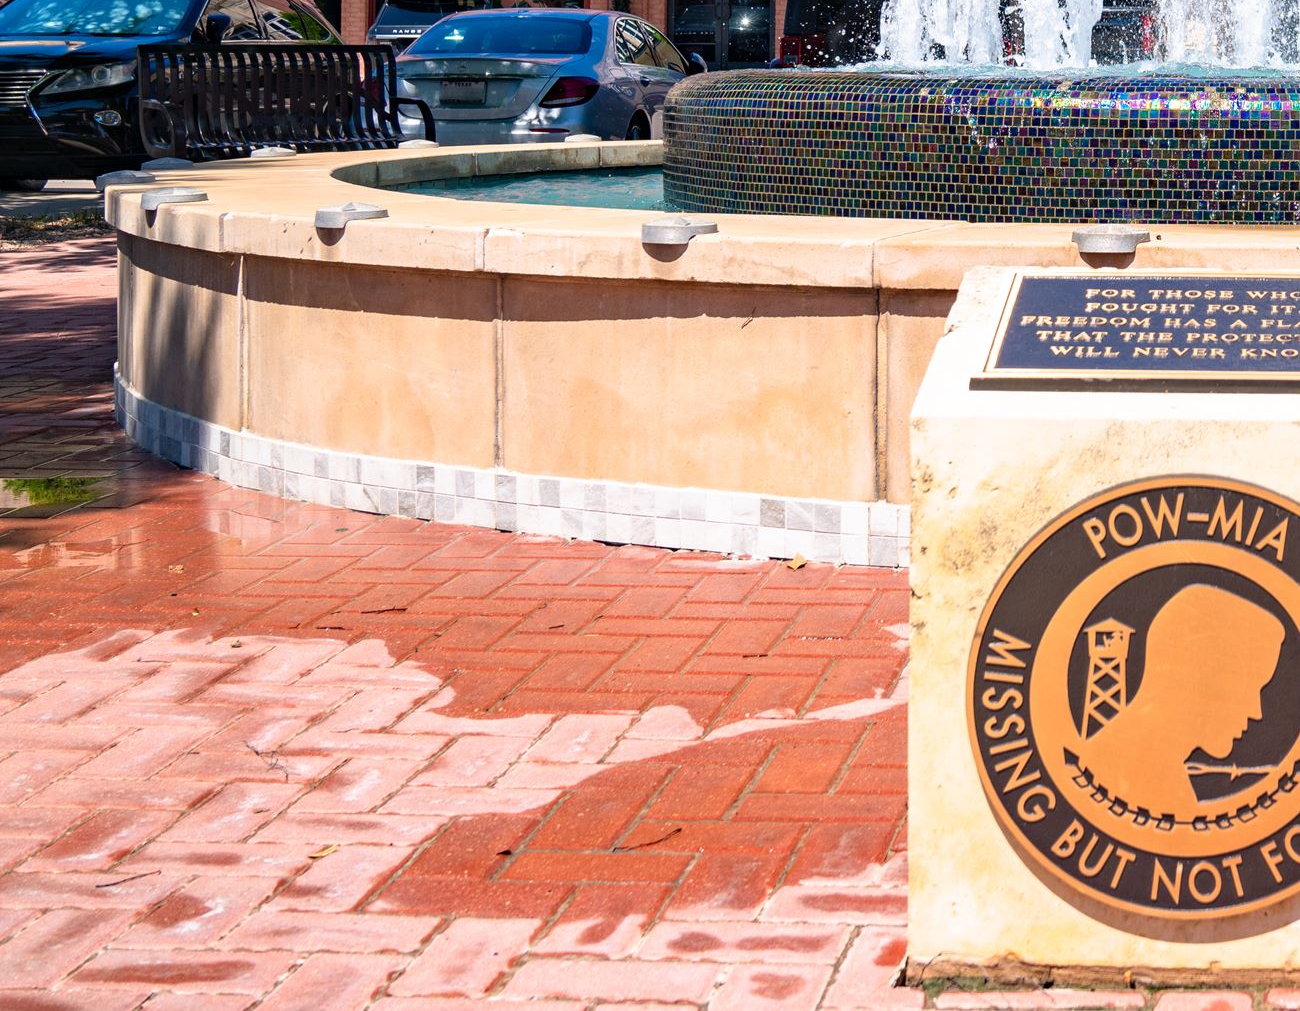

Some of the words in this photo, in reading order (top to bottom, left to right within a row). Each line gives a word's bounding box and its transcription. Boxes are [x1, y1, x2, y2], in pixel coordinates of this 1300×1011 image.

[1085, 288, 1136, 299] FOR
[1149, 289, 1234, 300] THOSE
[1084, 302, 1195, 314] FOUGHT
[1207, 304, 1258, 315] FOR
[1020, 315, 1151, 327] FREEDOM
[1164, 317, 1217, 328] HAS
[1230, 319, 1248, 329] A
[1036, 330, 1108, 342] THAT
[1120, 331, 1174, 343] THE
[1049, 345, 1120, 357] WILL
[1132, 347, 1226, 358] NEVER
[1082, 492, 1289, 562] POW-MIA
[981, 629, 1057, 823] MISSING
[1050, 819, 1137, 889] BUT
[1150, 856, 1245, 905] NOT
